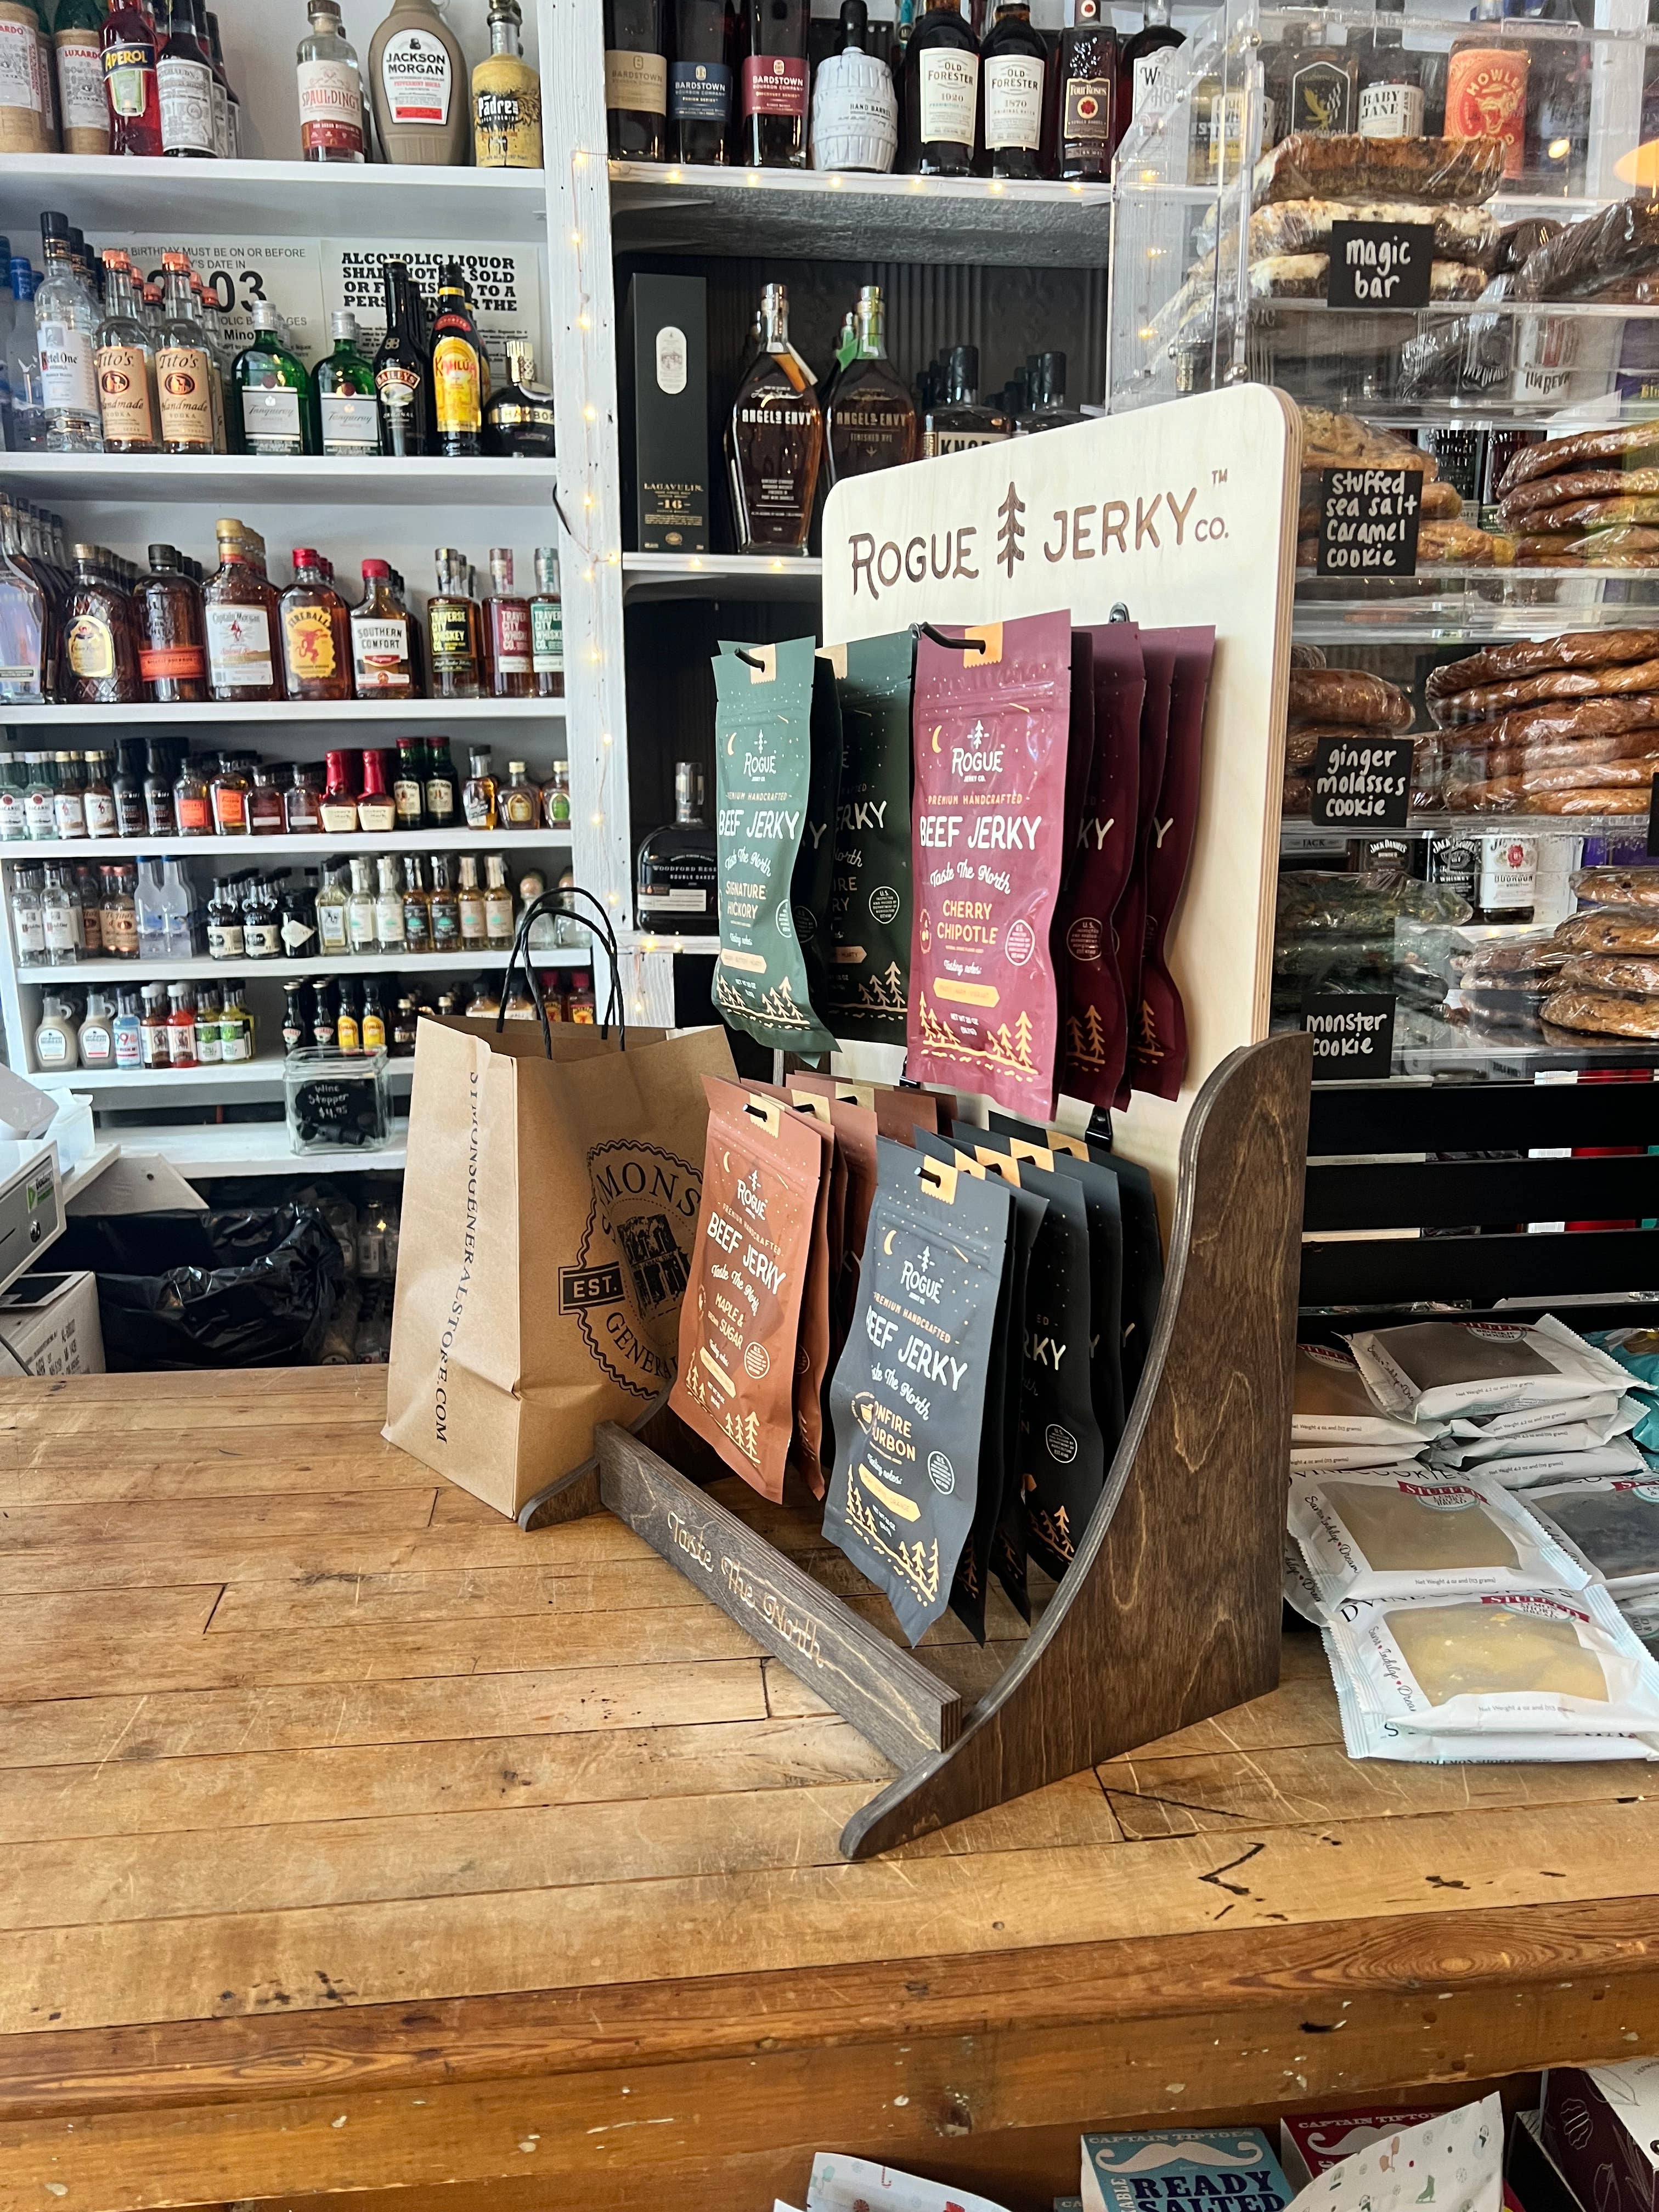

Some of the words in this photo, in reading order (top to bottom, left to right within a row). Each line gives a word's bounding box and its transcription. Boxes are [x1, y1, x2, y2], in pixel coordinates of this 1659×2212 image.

[105, 50, 148, 72] APEROL
[386, 53, 445, 64] JACKSON
[388, 64, 444, 76] MORGAN
[945, 63, 962, 71] OLD
[1007, 69, 1025, 77] OLD
[612, 70, 663, 82] BARDSTOWN
[753, 76, 803, 87] BARDSTOWN
[928, 70, 973, 86] FORESTER
[675, 82, 725, 92] BARDSTOWN
[992, 78, 1038, 91] FORESTER
[1363, 91, 1401, 108] BABY
[1362, 103, 1399, 119] JANE
[182, 248, 212, 257] MUST
[214, 248, 228, 257] BE
[229, 249, 245, 257] ON
[247, 249, 262, 257] OR
[265, 249, 306, 258] BEFORE
[342, 253, 443, 265] ALCOHOLIC
[448, 254, 515, 269] LIQUOR
[1346, 235, 1411, 275] magic
[207, 260, 233, 269] DATE
[236, 261, 246, 269] IN
[470, 270, 515, 283] SOLD
[1354, 270, 1400, 298] bar
[345, 281, 370, 294] OR
[477, 284, 500, 297] TO
[504, 285, 516, 297] A
[482, 299, 517, 312] THE
[60, 353, 78, 364] One
[98, 352, 134, 368] Tito's
[159, 353, 199, 369] Tito's
[376, 370, 416, 385] BAILEYS
[785, 411, 811, 426] ENVY
[880, 413, 907, 427] ENVY
[644, 483, 704, 492] LAGAVULIN
[664, 500, 682, 509] 16
[1326, 497, 1359, 517] sea
[1368, 494, 1418, 517] salt
[848, 525, 979, 600] ROGUE
[1043, 486, 1198, 563] JERKY
[1327, 543, 1396, 568] cookie
[288, 611, 330, 629] FIREBALL
[431, 611, 466, 623] TRAVERSE
[358, 628, 403, 639] SOUTHERN
[431, 622, 447, 631] CITY
[501, 622, 519, 631] CITY
[535, 622, 552, 631] CITY
[432, 631, 465, 641] WHISKEY
[362, 639, 400, 650] COMFORT
[743, 752, 777, 777] ROGUE
[952, 747, 1003, 775] ROGUE
[1329, 745, 1397, 774] ginger
[1317, 772, 1405, 796] molasses
[748, 792, 788, 802] HANDCRAFTED
[928, 794, 961, 805] PREMIUM
[963, 793, 1023, 805] HANDCRAFTED
[1325, 797, 1386, 817] cookie
[719, 809, 744, 837] BEEF
[746, 810, 800, 840] JERKY
[919, 815, 963, 849] BEEF
[968, 815, 1042, 850] JERKY
[1370, 841, 1385, 854] JACK
[1433, 838, 1452, 854] JACK
[930, 859, 955, 888] Taste
[956, 859, 975, 879] The
[978, 865, 1011, 895] North
[725, 880, 766, 900] SIGNATURE
[727, 901, 759, 919] HICKORY
[942, 900, 992, 920] CHERRY
[936, 922, 999, 945] CHIPOTLE
[1307, 1013, 1387, 1033] monster
[1313, 1032, 1374, 1057] cookie
[737, 1179, 767, 1221] ROGUE
[722, 1203, 743, 1226] PREMIUM
[743, 1221, 781, 1257] HANDCRAFTED
[707, 1212, 743, 1255] BEEF
[742, 1243, 787, 1295] JERKY
[711, 1263, 730, 1282] Taste
[730, 1269, 744, 1290] The
[900, 1260, 944, 1305] ROGUE
[573, 1275, 617, 1300] EST.
[715, 1293, 740, 1322] MAPLE
[737, 1313, 744, 1328] &
[719, 1318, 743, 1350] SUGAR
[902, 1312, 952, 1345] HANDCRAFTED
[898, 1333, 968, 1392] JERKY
[884, 1368, 900, 1396] The
[901, 1384, 930, 1421] North
[1339, 1544, 1360, 1575] Dream
[667, 1510, 714, 1573] Taste
[721, 1555, 755, 1609] The
[761, 1592, 824, 1668] North
[1426, 1577, 1446, 1586] Weight
[1378, 1647, 1400, 1680] Indulge
[1298, 2117, 1373, 2129] CAPTAIN
[1089, 2134, 1169, 2143] CAPTAIN
[1128, 2170, 1273, 2200] READY
[1136, 2194, 1286, 2212] SALTED
